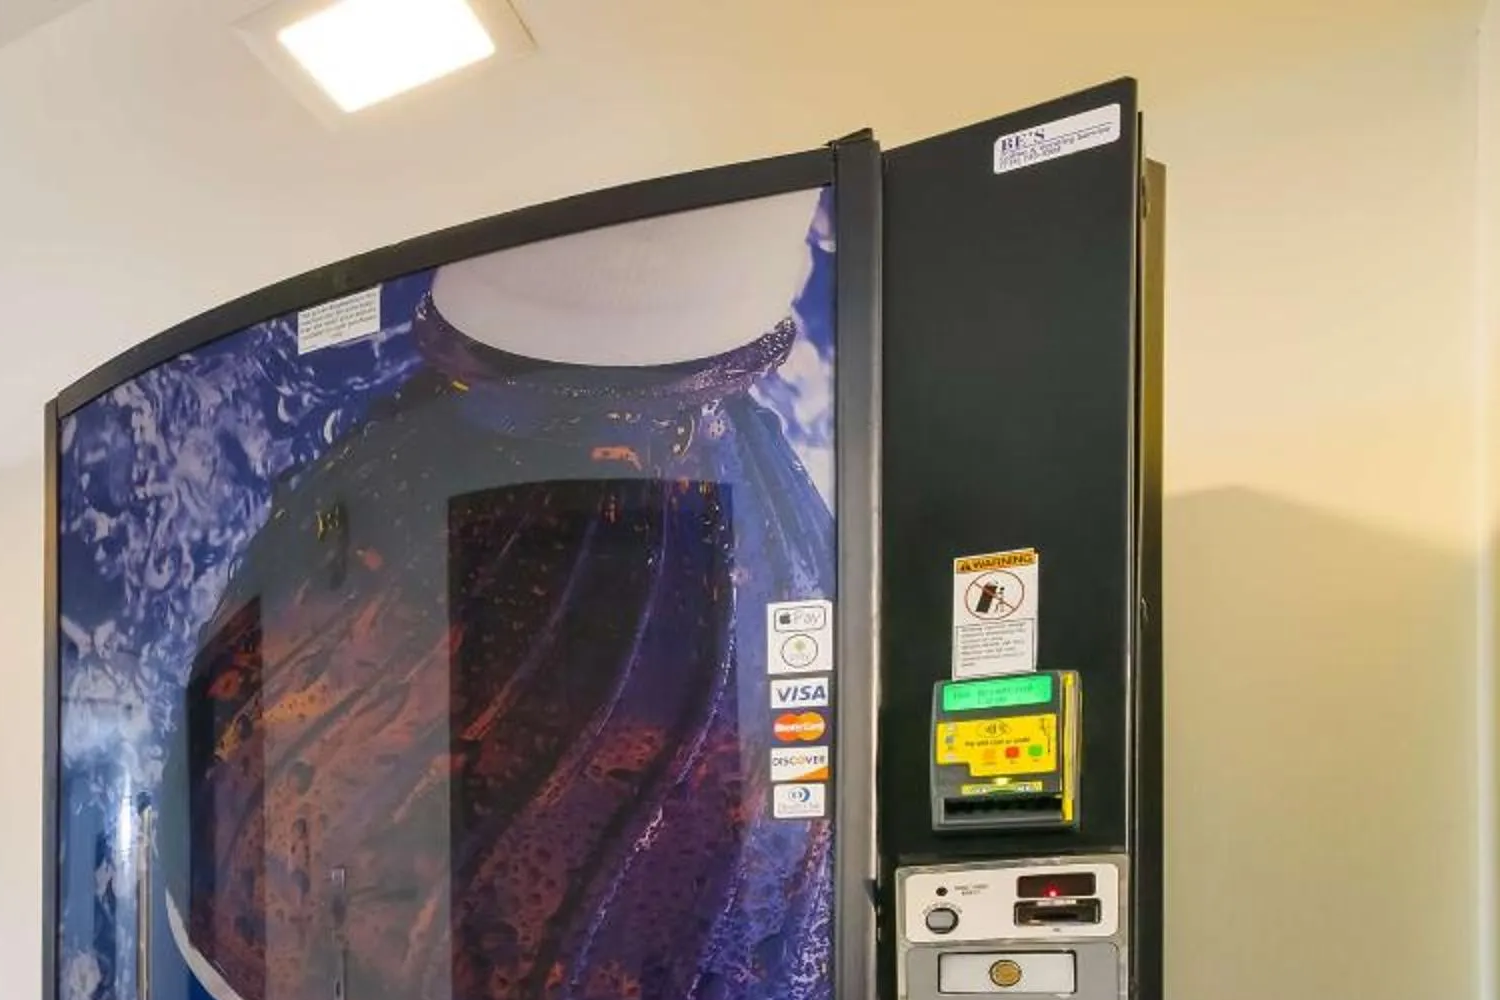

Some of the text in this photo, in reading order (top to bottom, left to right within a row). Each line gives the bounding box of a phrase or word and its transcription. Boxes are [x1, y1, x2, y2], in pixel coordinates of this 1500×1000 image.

[972, 552, 1034, 569] WARNING
[793, 610, 821, 626] Pay
[775, 684, 826, 702] VISA
[772, 754, 826, 767] DISCOVER
